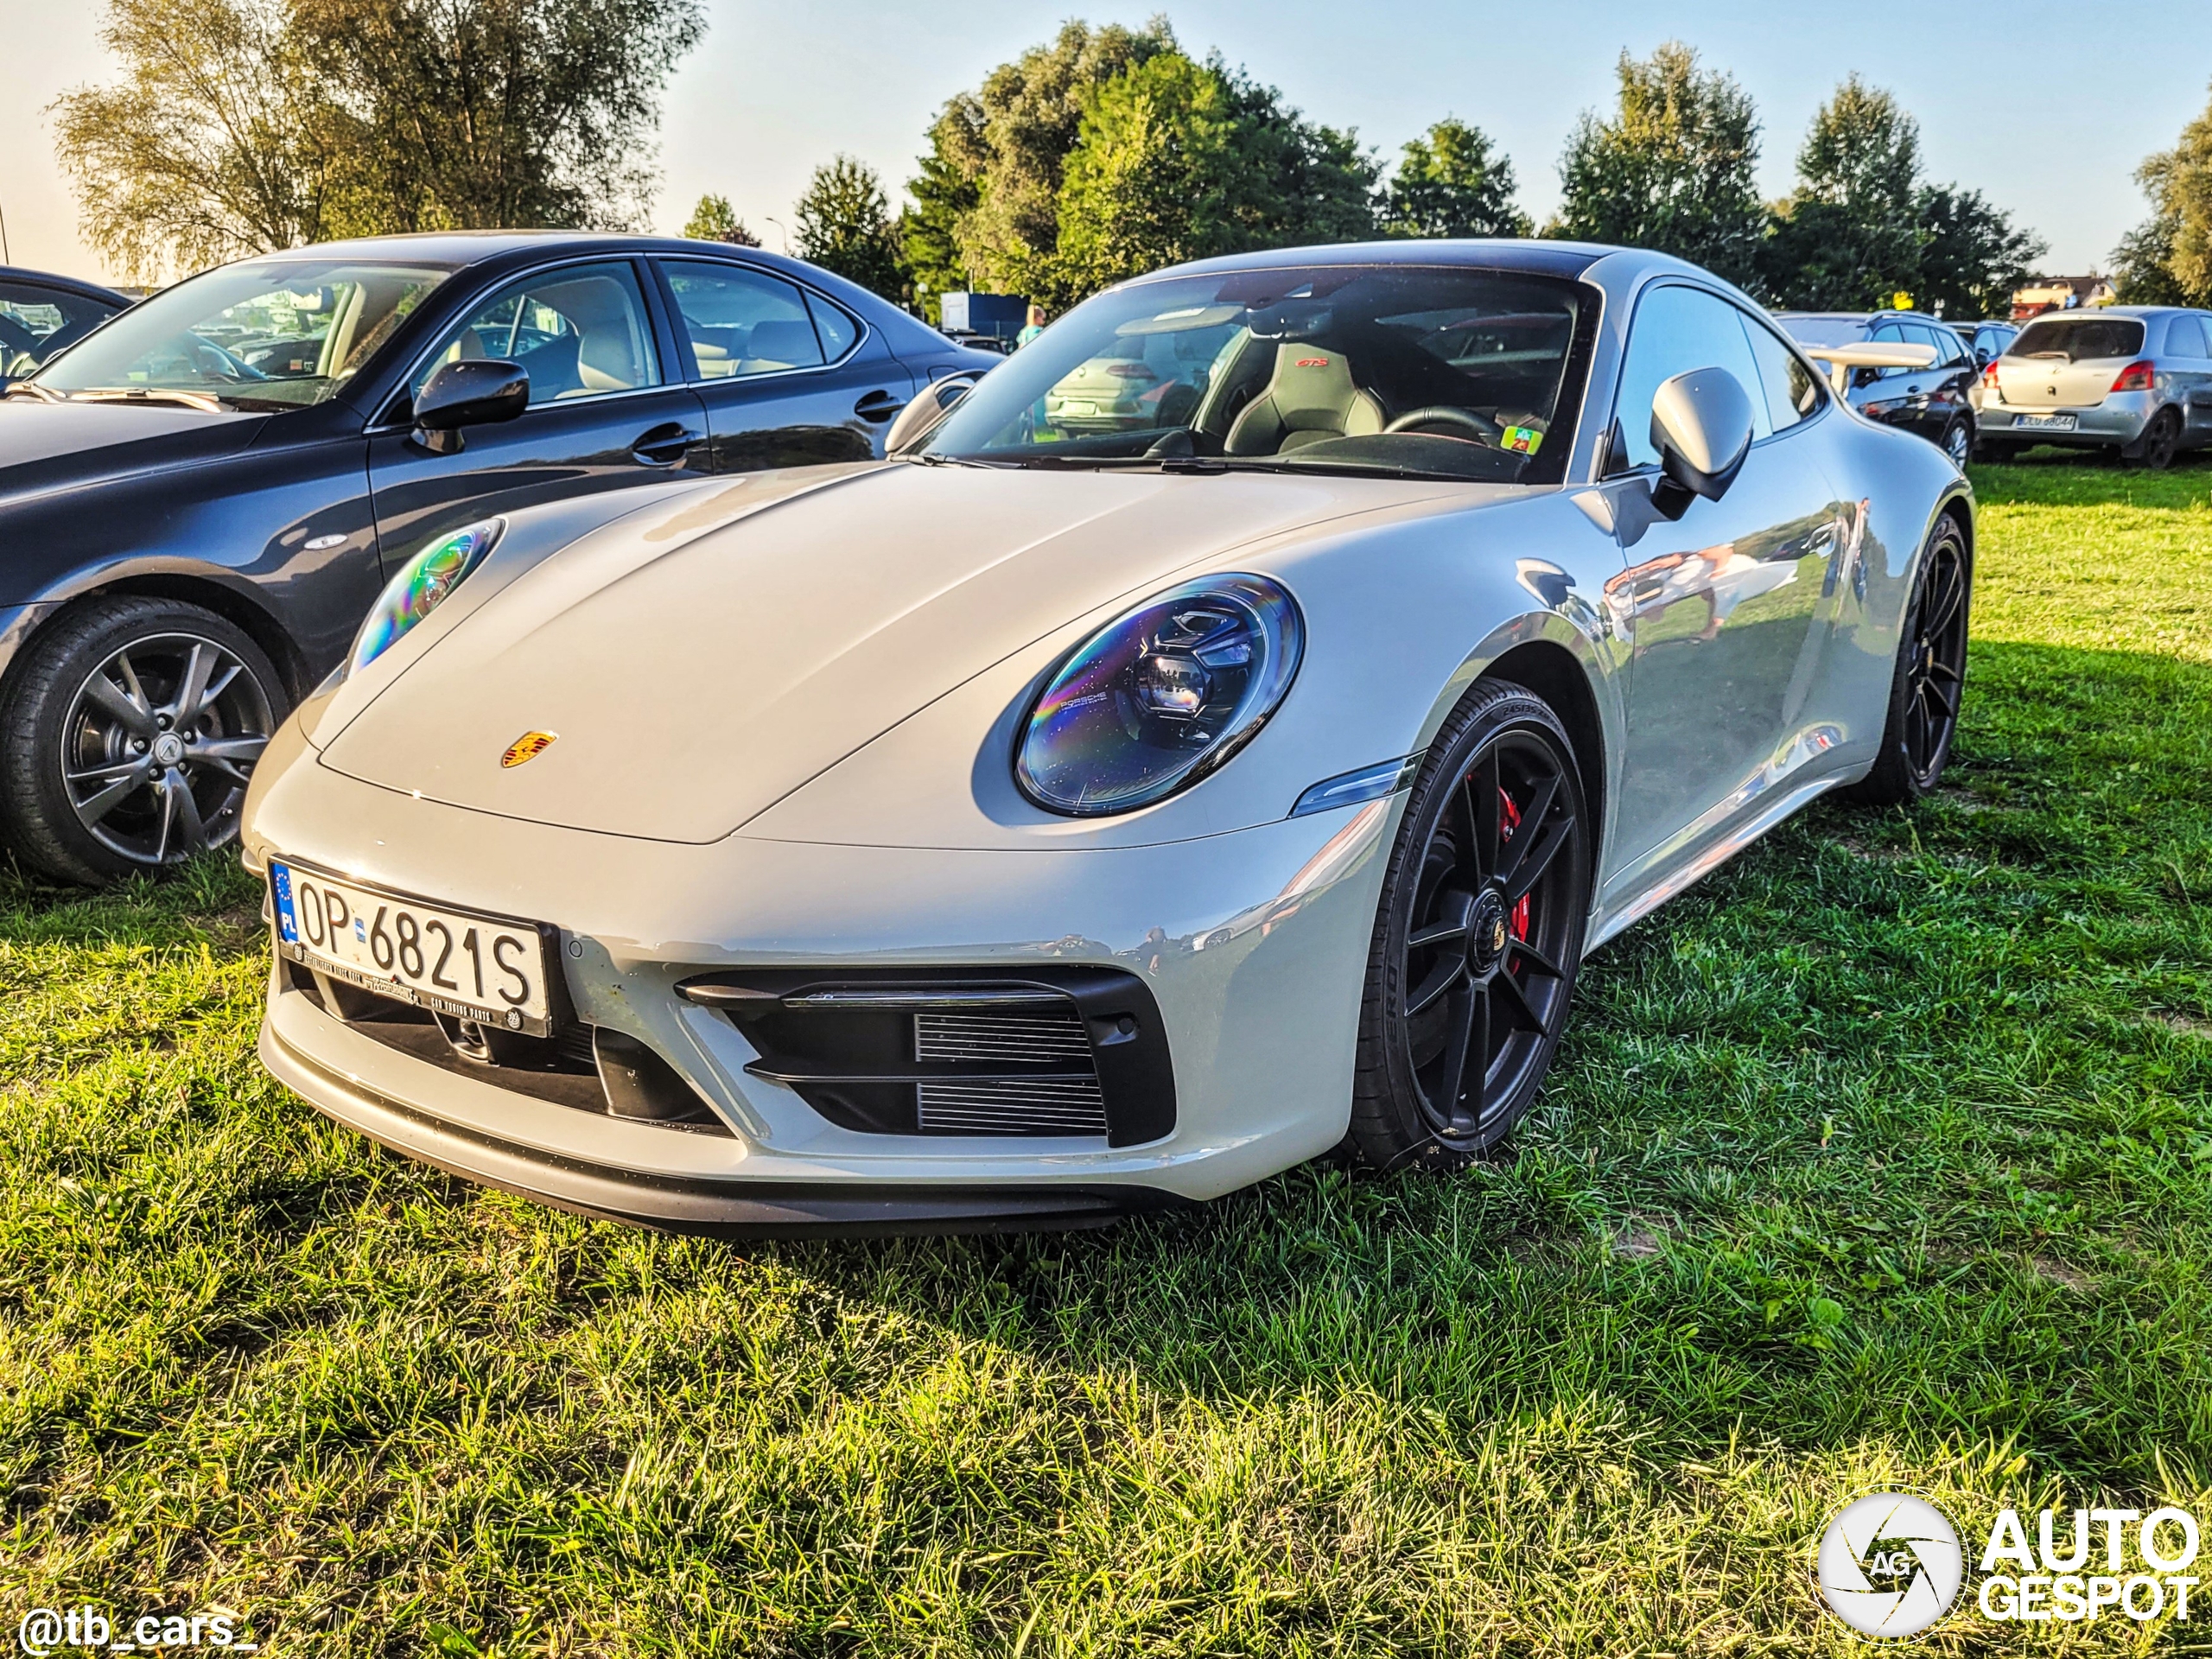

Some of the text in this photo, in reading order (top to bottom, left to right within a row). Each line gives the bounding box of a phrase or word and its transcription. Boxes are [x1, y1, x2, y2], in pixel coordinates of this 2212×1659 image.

[1294, 357, 1327, 366] GTS
[1060, 691, 1107, 708] PORSCHE
[281, 912, 296, 933] PL
[300, 881, 529, 1006] OP 6821S
